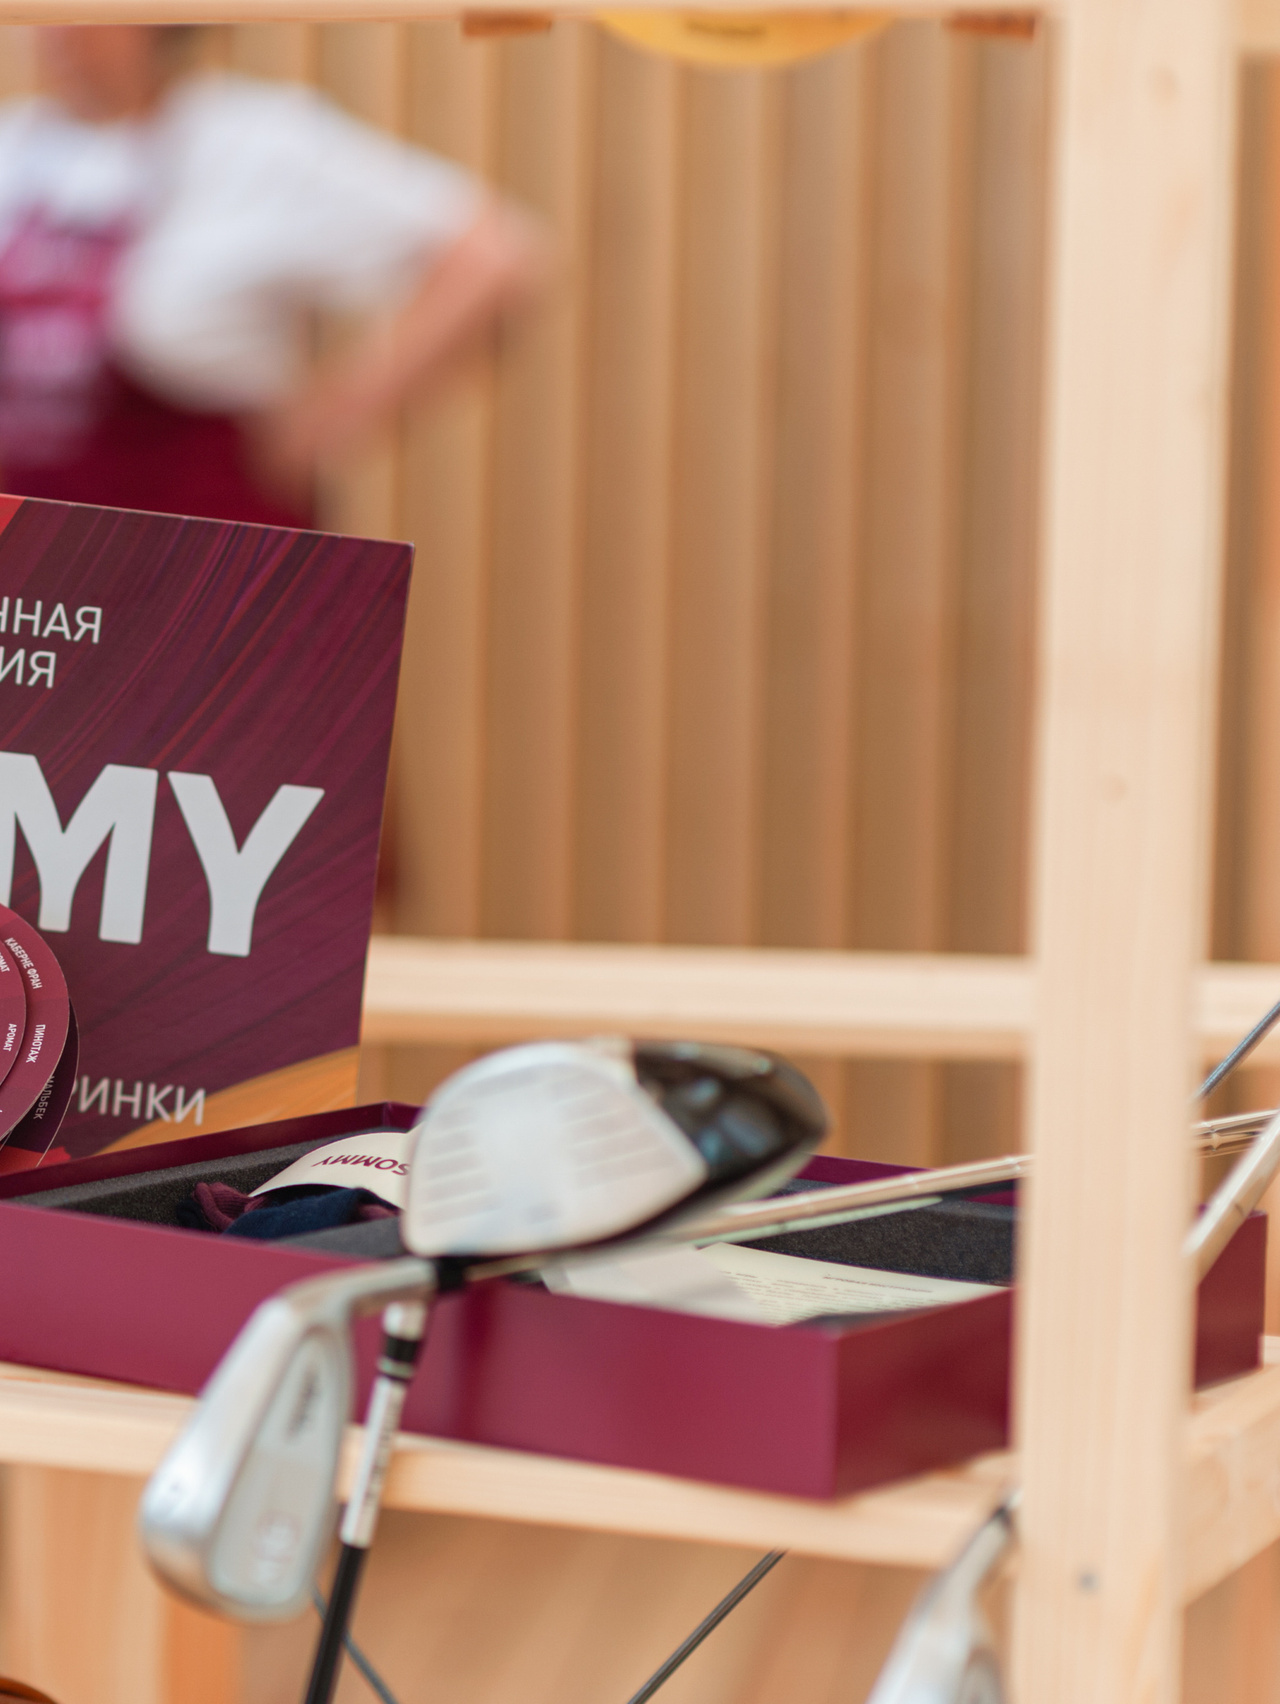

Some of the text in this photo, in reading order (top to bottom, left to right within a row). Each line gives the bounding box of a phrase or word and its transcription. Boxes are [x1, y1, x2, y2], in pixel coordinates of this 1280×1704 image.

[4, 937, 43, 990] КАБЕРНЕ ФРАН
[3, 1023, 17, 1051] АРОМАТ
[26, 1024, 46, 1063] ПИНОТАЖ
[311, 1154, 410, 1176] SOMMY
